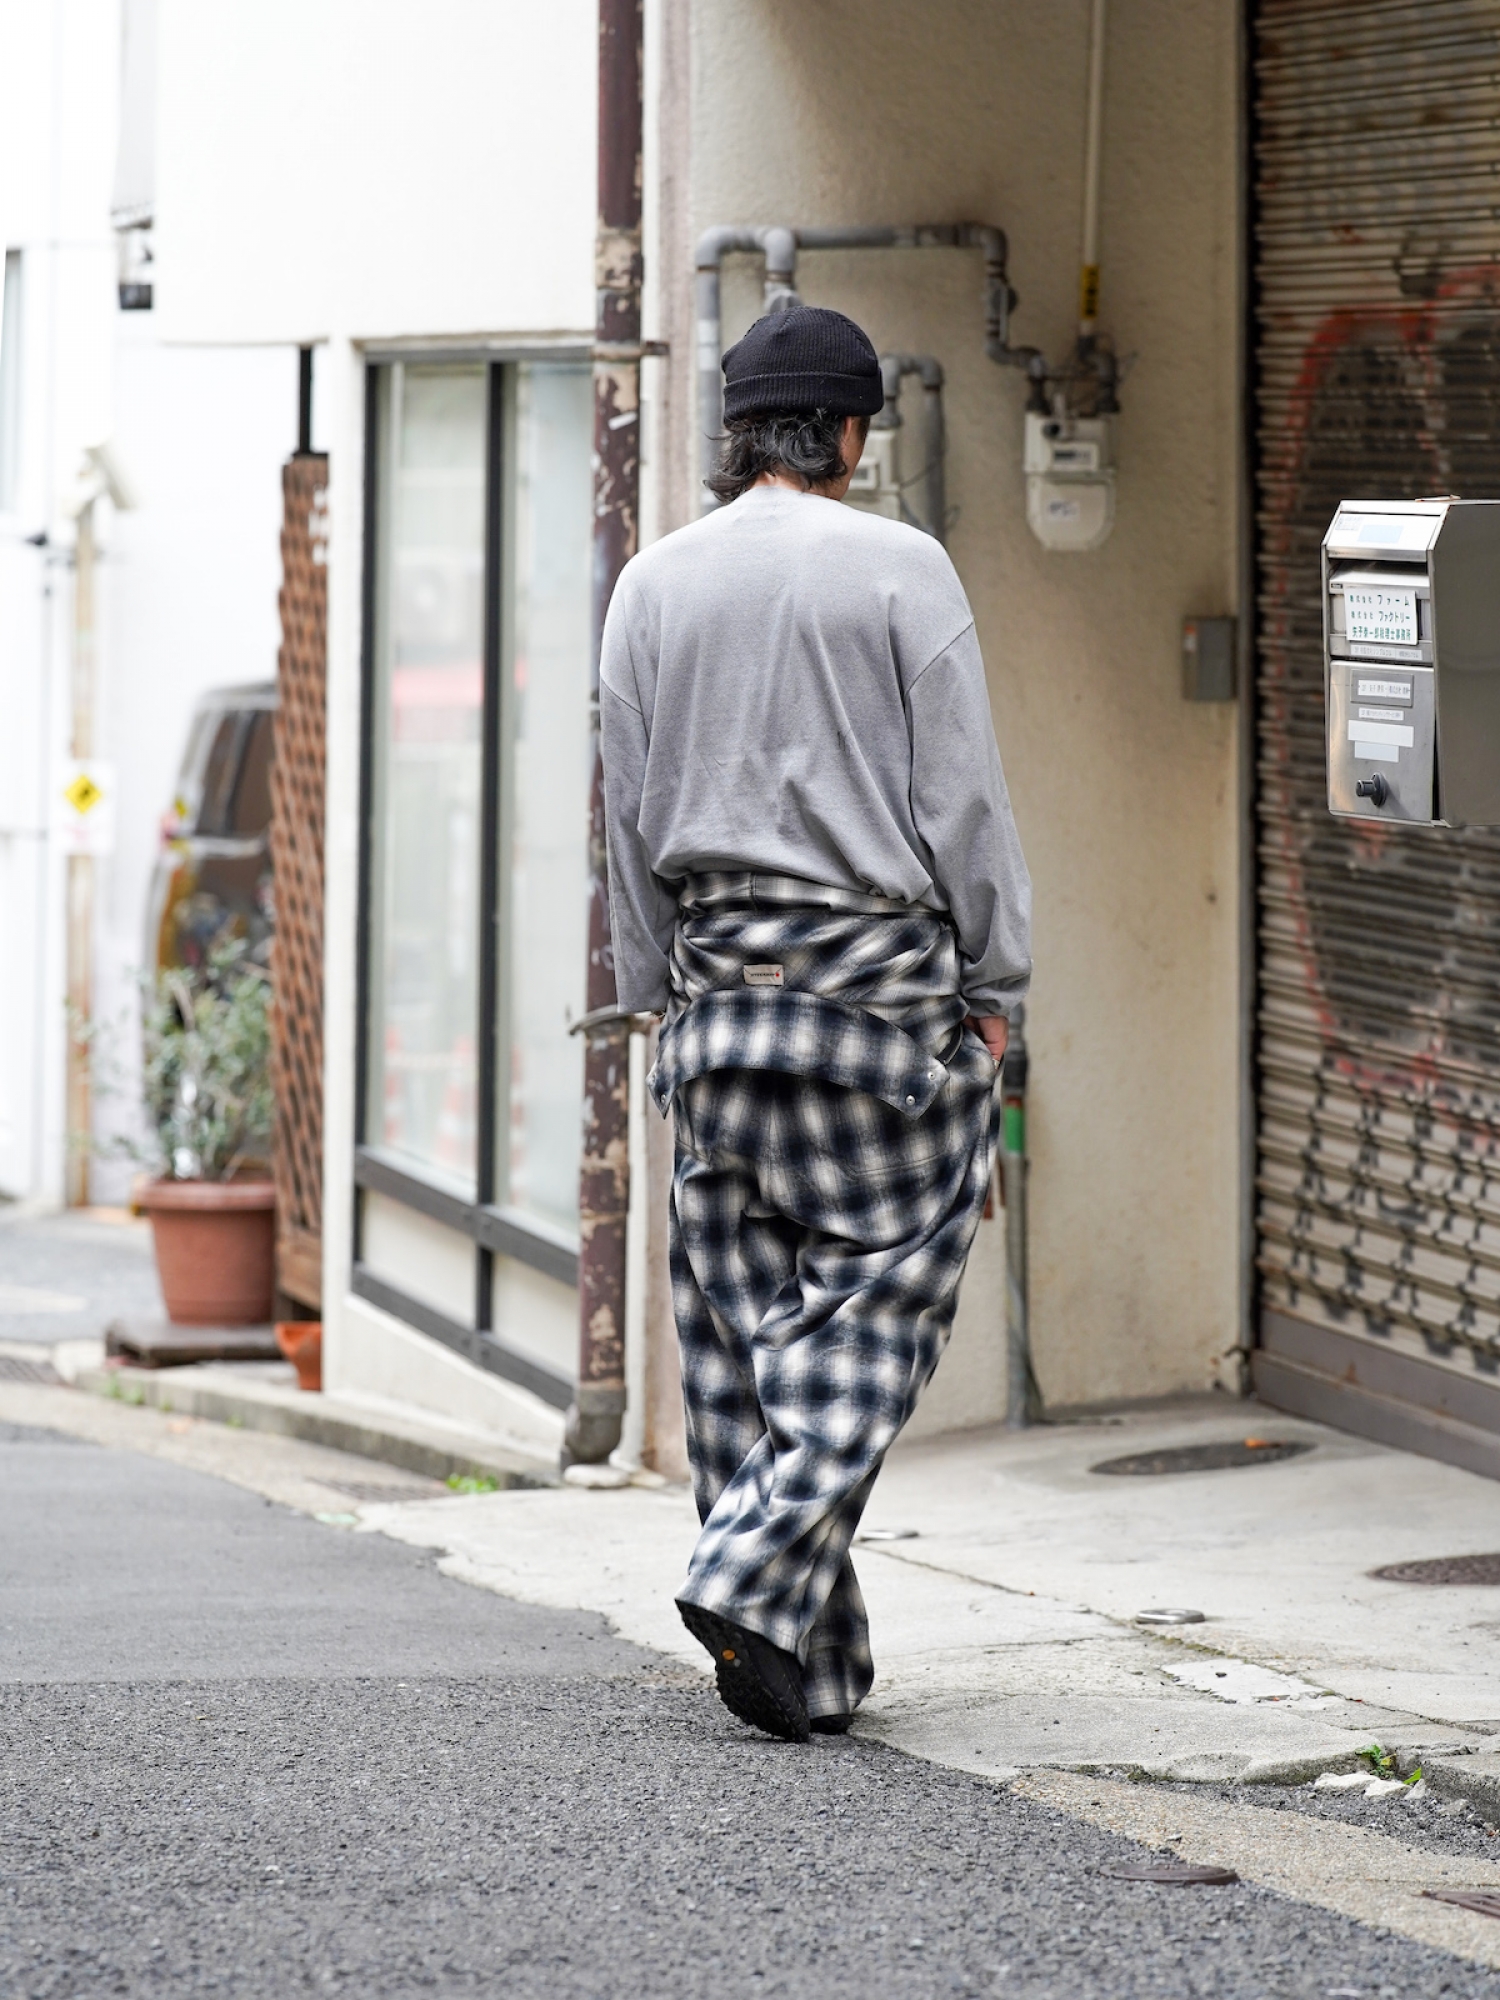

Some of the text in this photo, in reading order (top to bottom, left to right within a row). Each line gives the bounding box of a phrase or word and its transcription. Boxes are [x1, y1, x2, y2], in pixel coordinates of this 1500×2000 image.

[1378, 610, 1411, 623] ファクトリー
